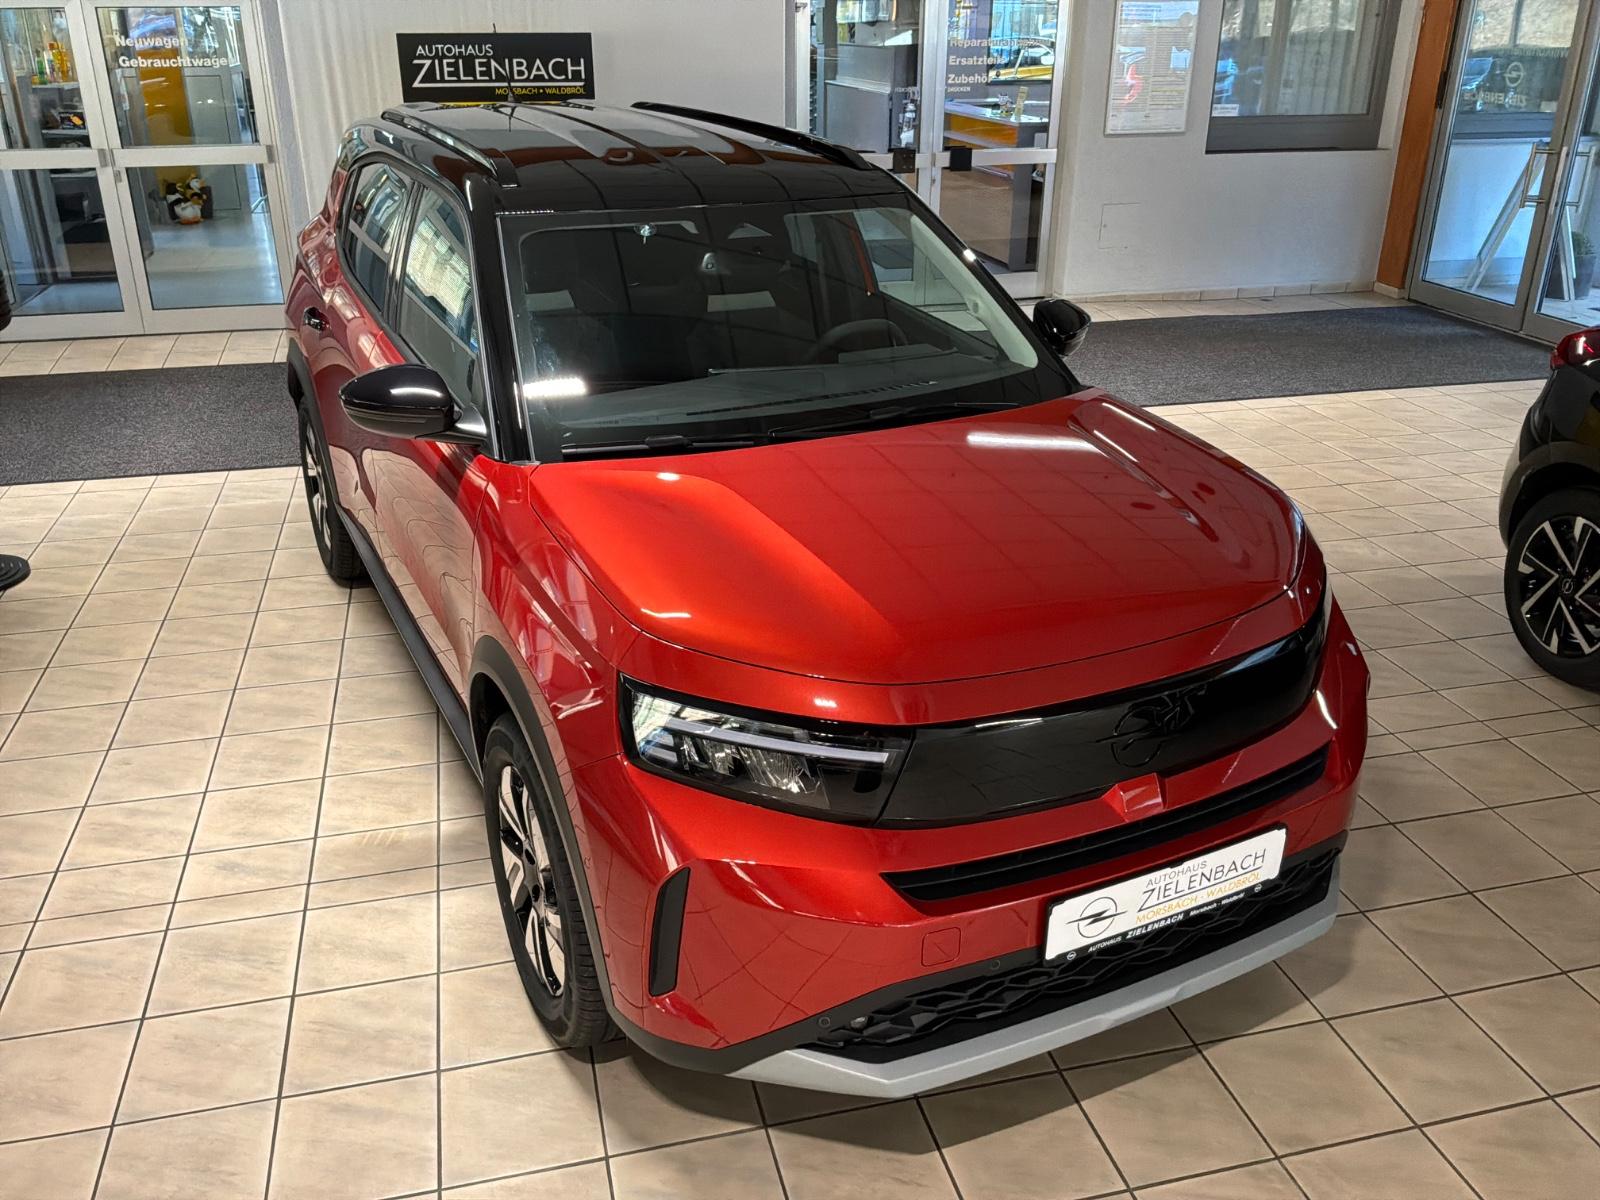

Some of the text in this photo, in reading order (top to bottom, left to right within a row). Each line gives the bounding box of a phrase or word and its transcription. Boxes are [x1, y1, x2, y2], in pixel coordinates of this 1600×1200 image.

[116, 35, 188, 48] Neuwagen
[415, 44, 494, 57] AUTOHAUS
[119, 55, 230, 69] Gebrauchtwage
[948, 55, 1007, 66] Ersatzteile
[411, 57, 586, 88] ZIELENBACH
[947, 72, 993, 85] Zubehör
[544, 86, 586, 95] WALDBRÖL
[1137, 848, 1267, 912] ZIELENBACH
[1145, 860, 1207, 888] AUTOHAUS
[1135, 894, 1199, 924] MORSBACH
[1205, 871, 1261, 898] WALDBRÖL
[1088, 936, 1122, 953] AUTOHAUS
[1126, 913, 1184, 939] ZIELENBACH
